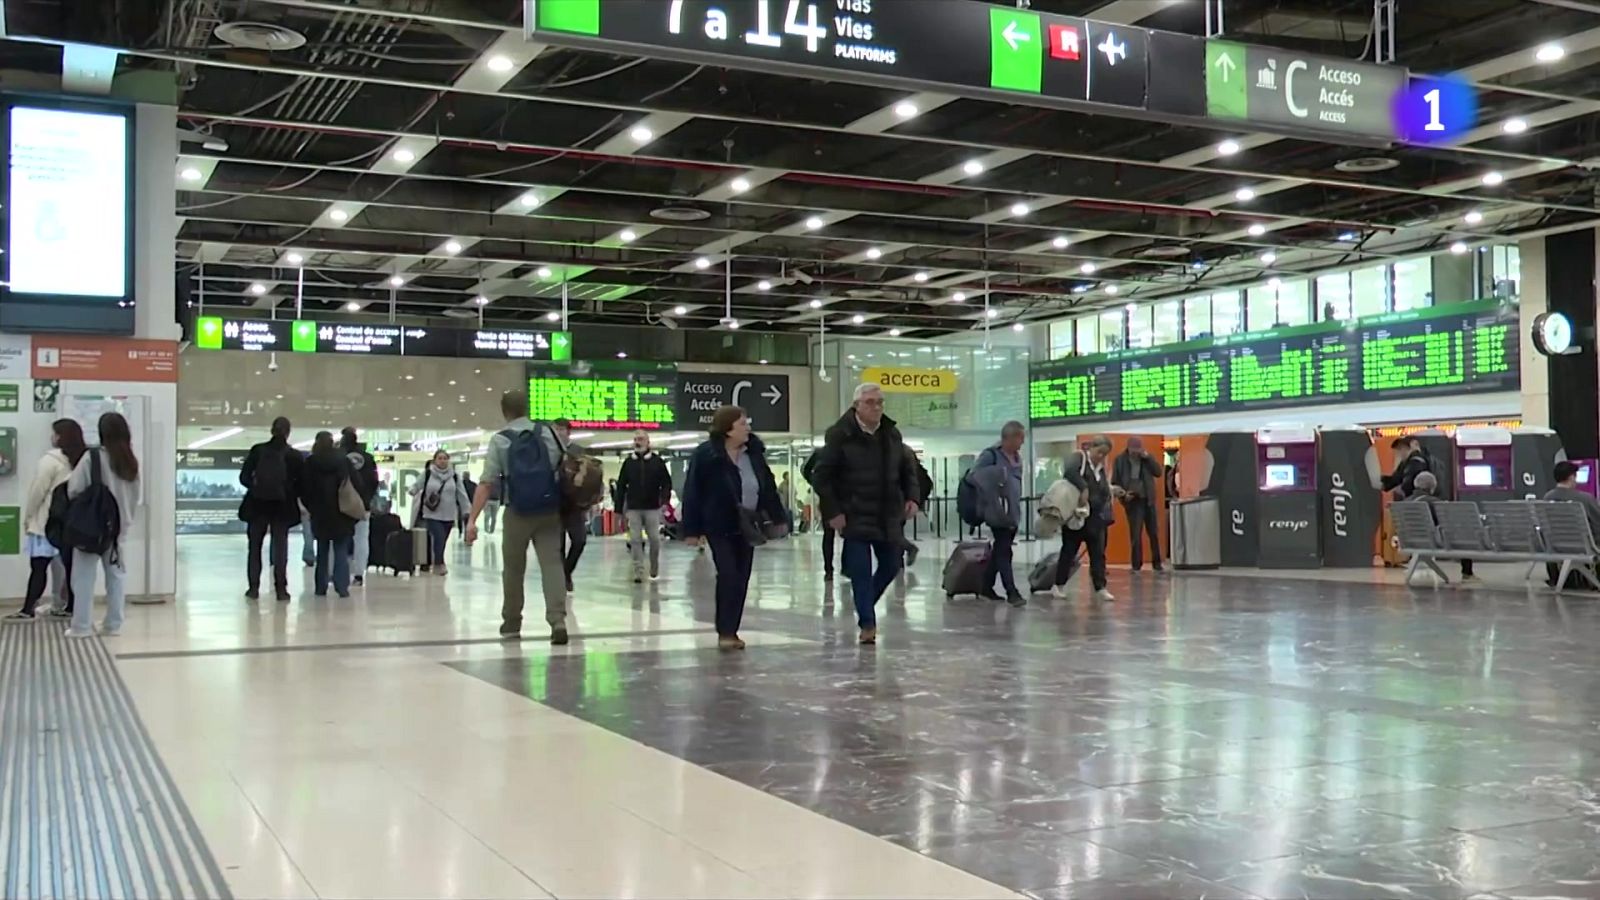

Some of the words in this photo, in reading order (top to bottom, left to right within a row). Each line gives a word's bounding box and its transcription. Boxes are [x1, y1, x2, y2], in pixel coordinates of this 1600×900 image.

[704, 7, 727, 40] a
[745, 0, 827, 52] 14
[834, 16, 873, 40] Vies
[835, 43, 896, 64] PLATFORMS
[1319, 65, 1361, 86] Acceso
[1285, 60, 1308, 117] C
[1319, 87, 1354, 107] Accés
[1319, 111, 1346, 124] ACCESS
[336, 325, 363, 335] Control
[684, 381, 723, 394] Acceso
[880, 373, 941, 388] acerca
[691, 397, 723, 410] Accés
